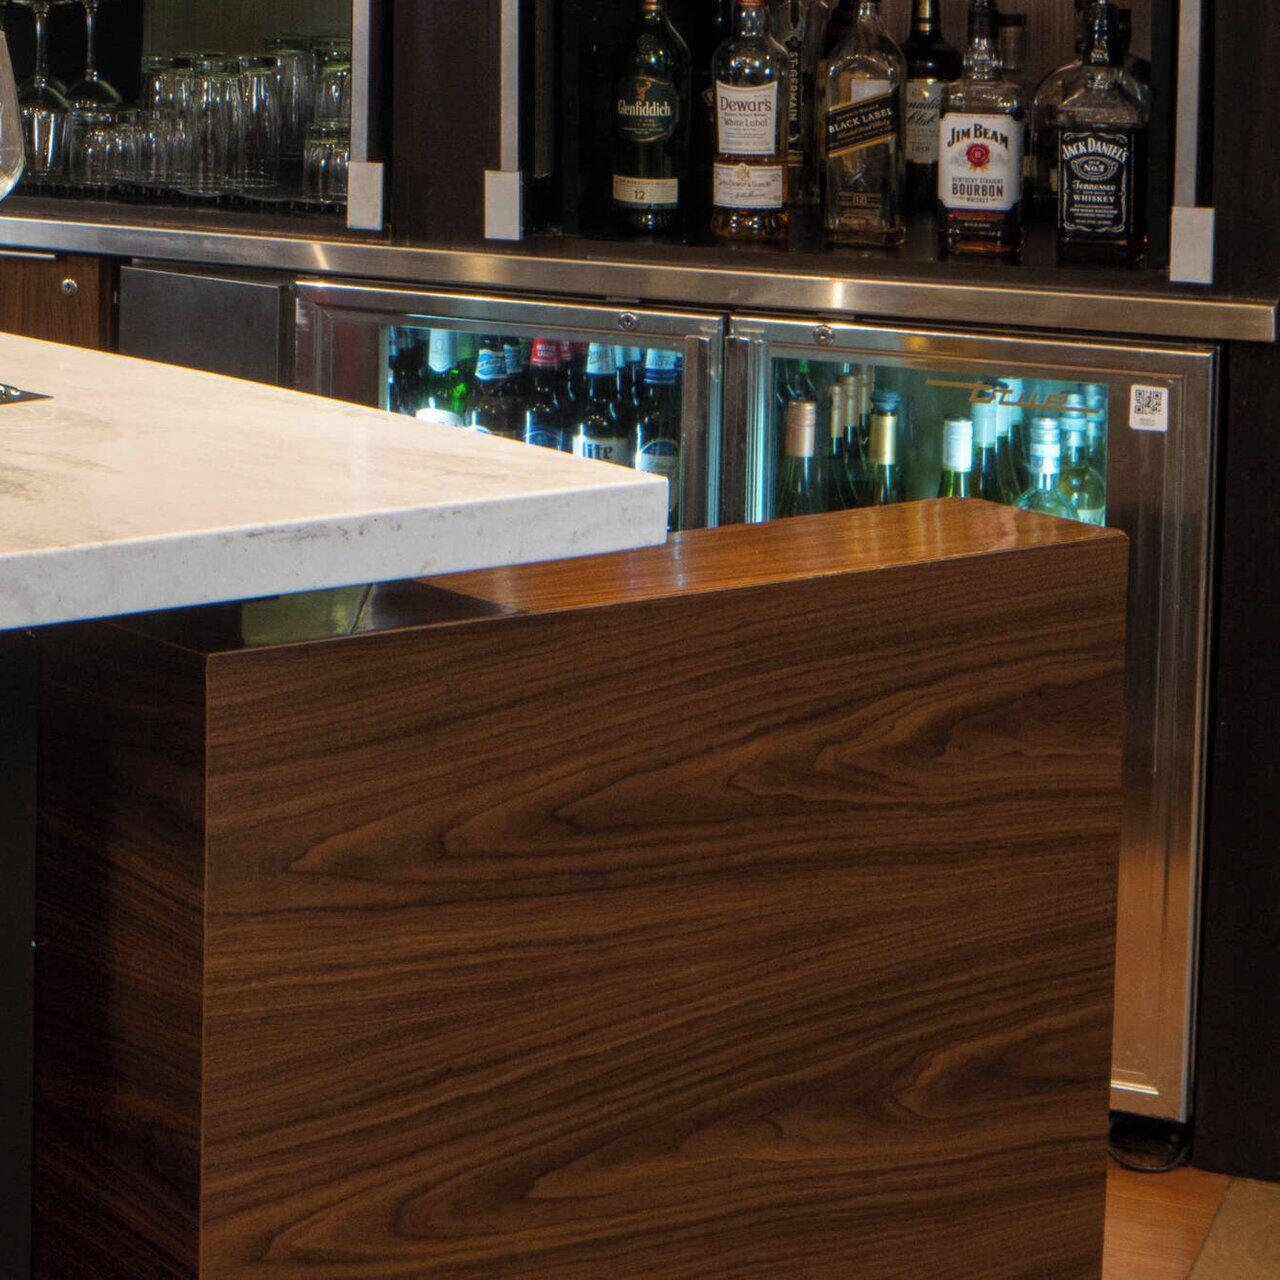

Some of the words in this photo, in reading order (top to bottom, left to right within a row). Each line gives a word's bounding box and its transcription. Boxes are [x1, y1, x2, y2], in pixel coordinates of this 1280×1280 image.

[617, 99, 671, 117] Glenfiddich
[720, 96, 772, 113] Dewar's
[745, 118, 769, 128] Label
[828, 118, 861, 134] BLACK
[862, 108, 894, 123] LABEL
[947, 126, 971, 148] JIM
[973, 123, 1009, 148] BEAM
[1062, 141, 1087, 160] JACK
[1088, 137, 1130, 164] DANIEL'S
[952, 184, 1004, 198] BOURBON
[1071, 179, 1117, 191] Tennessee
[634, 190, 646, 200] 12
[1073, 195, 1115, 203] WHISKEY
